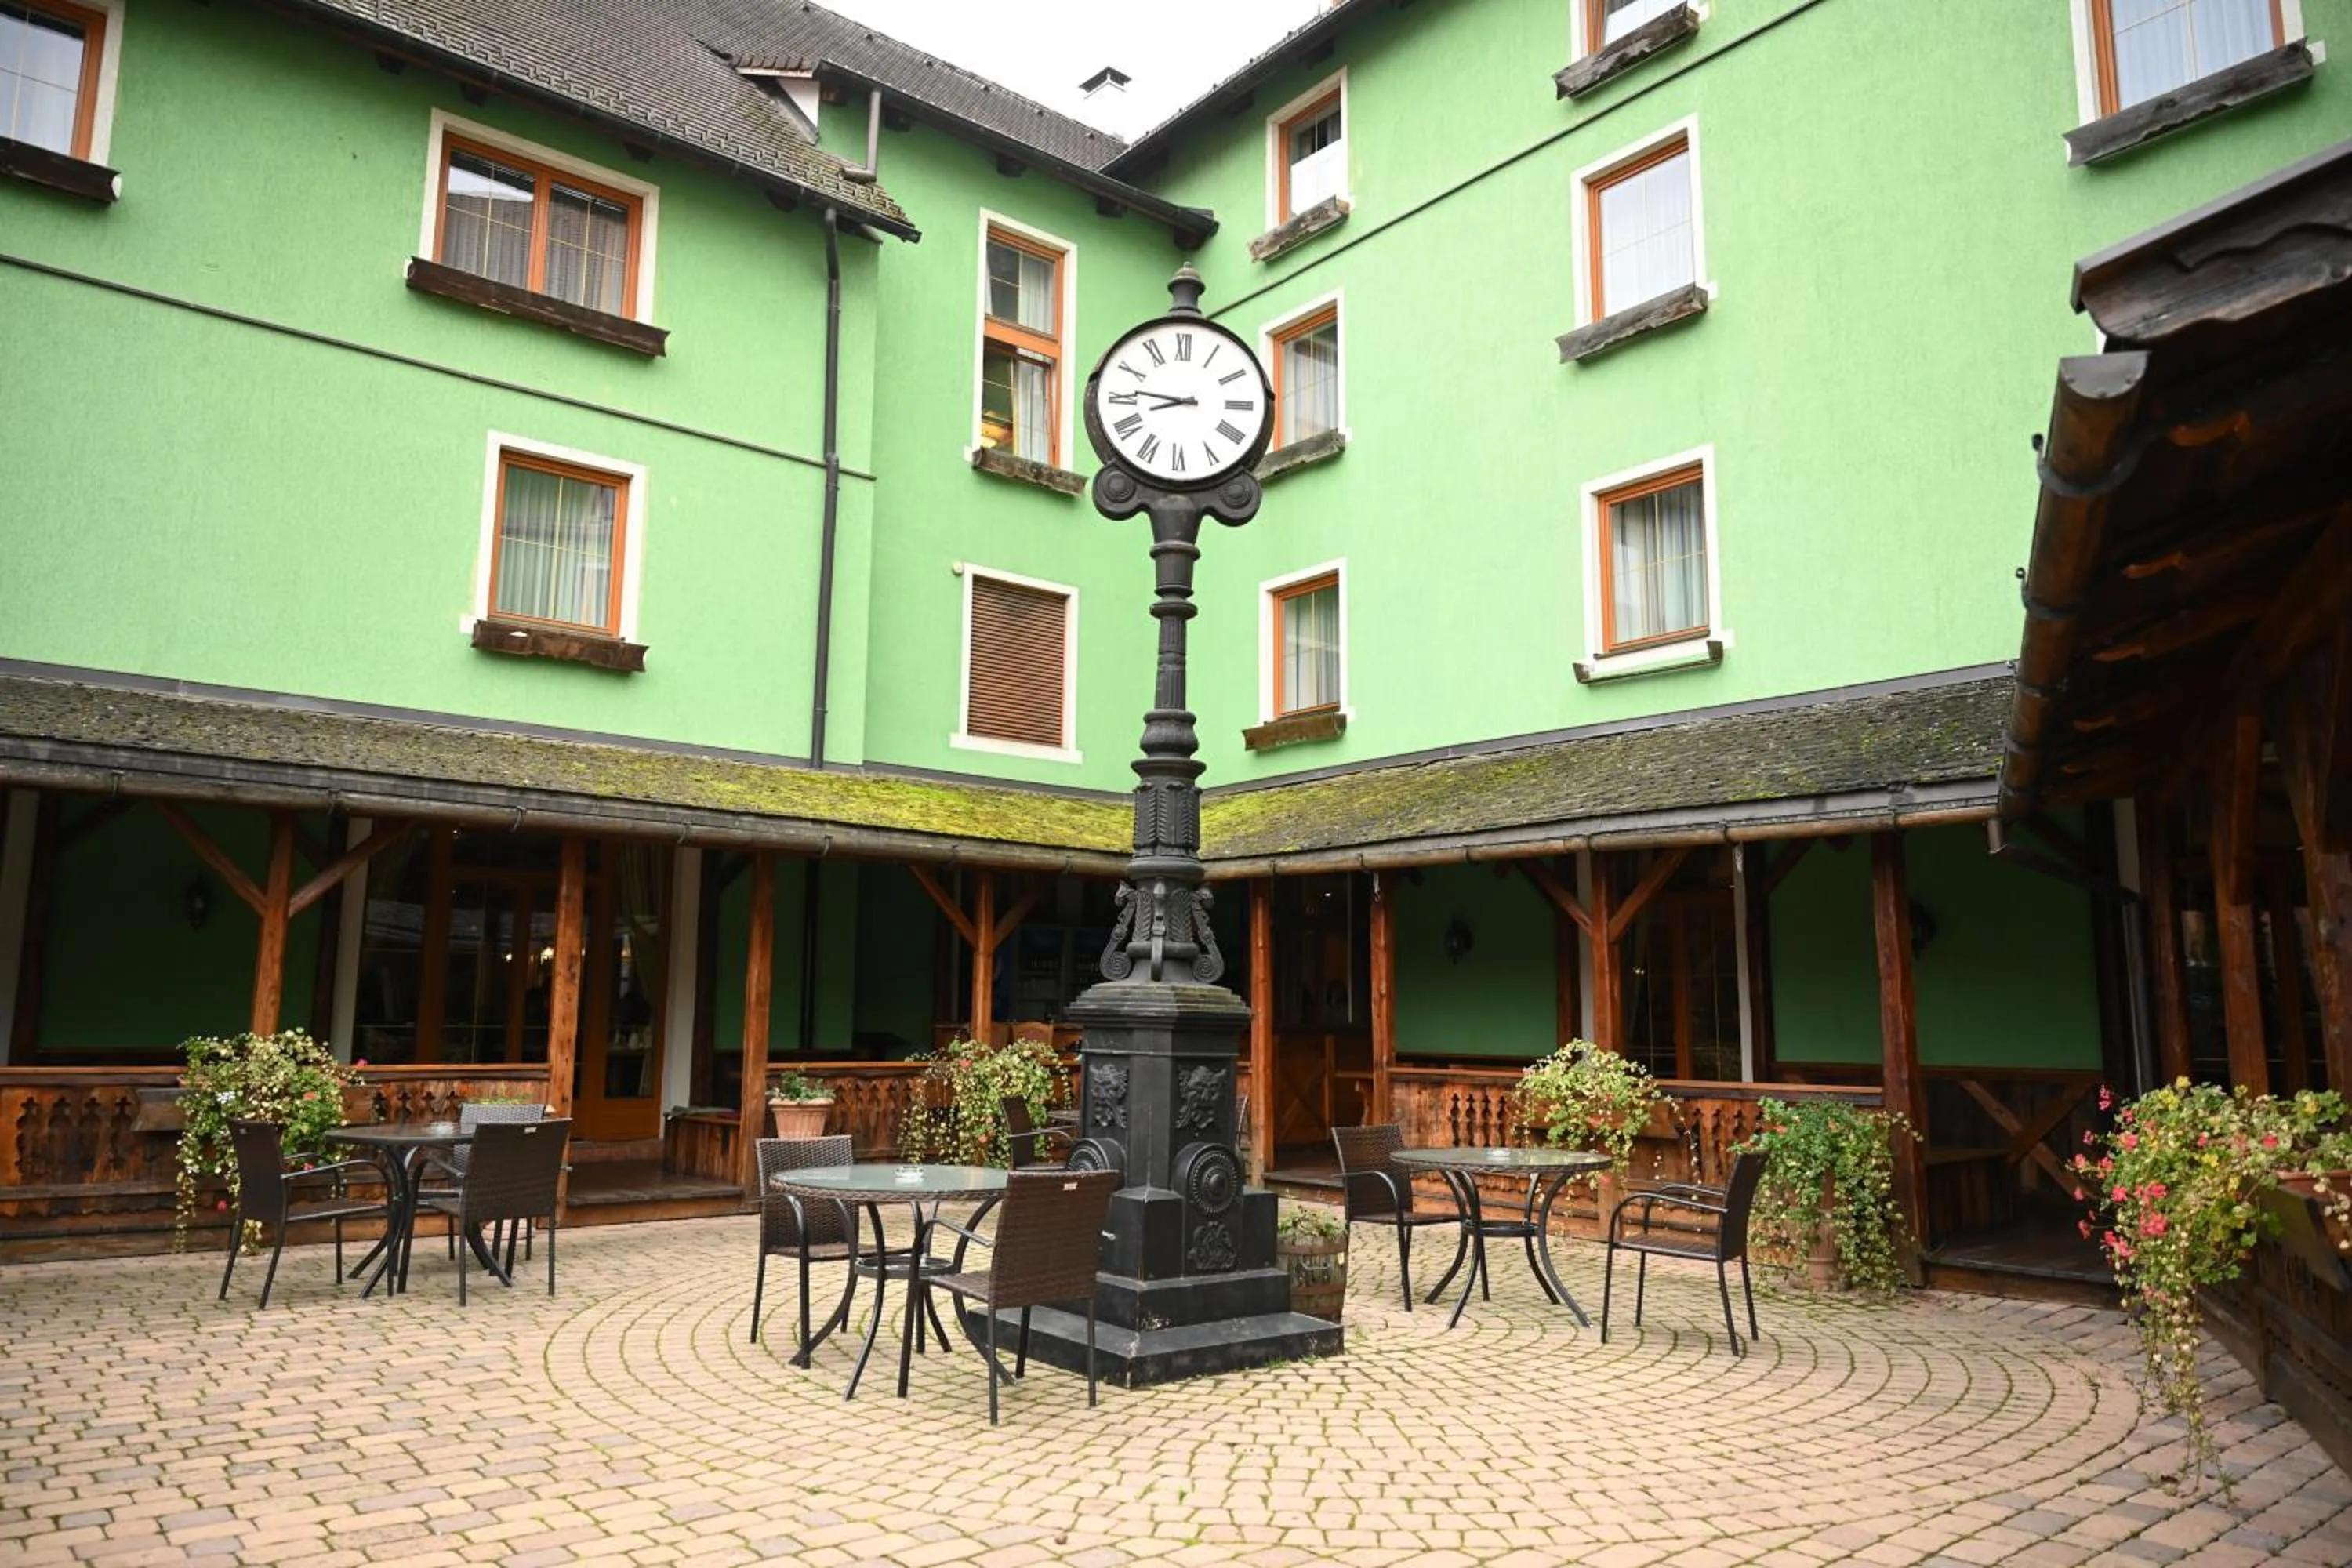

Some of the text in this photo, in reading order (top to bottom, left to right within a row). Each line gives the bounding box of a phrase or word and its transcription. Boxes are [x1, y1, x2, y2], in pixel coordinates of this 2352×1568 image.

[1142, 339, 1165, 367] XI
[1175, 332, 1192, 361] XII
[1203, 345, 1220, 368] I
[1118, 361, 1146, 382] X
[1218, 368, 1247, 385] II
[1109, 391, 1138, 405] IX
[1225, 400, 1254, 411] III
[1113, 412, 1143, 441] VIII
[1136, 433, 1160, 464] VII
[1172, 443, 1185, 471] VI
[1203, 441, 1220, 466] V
